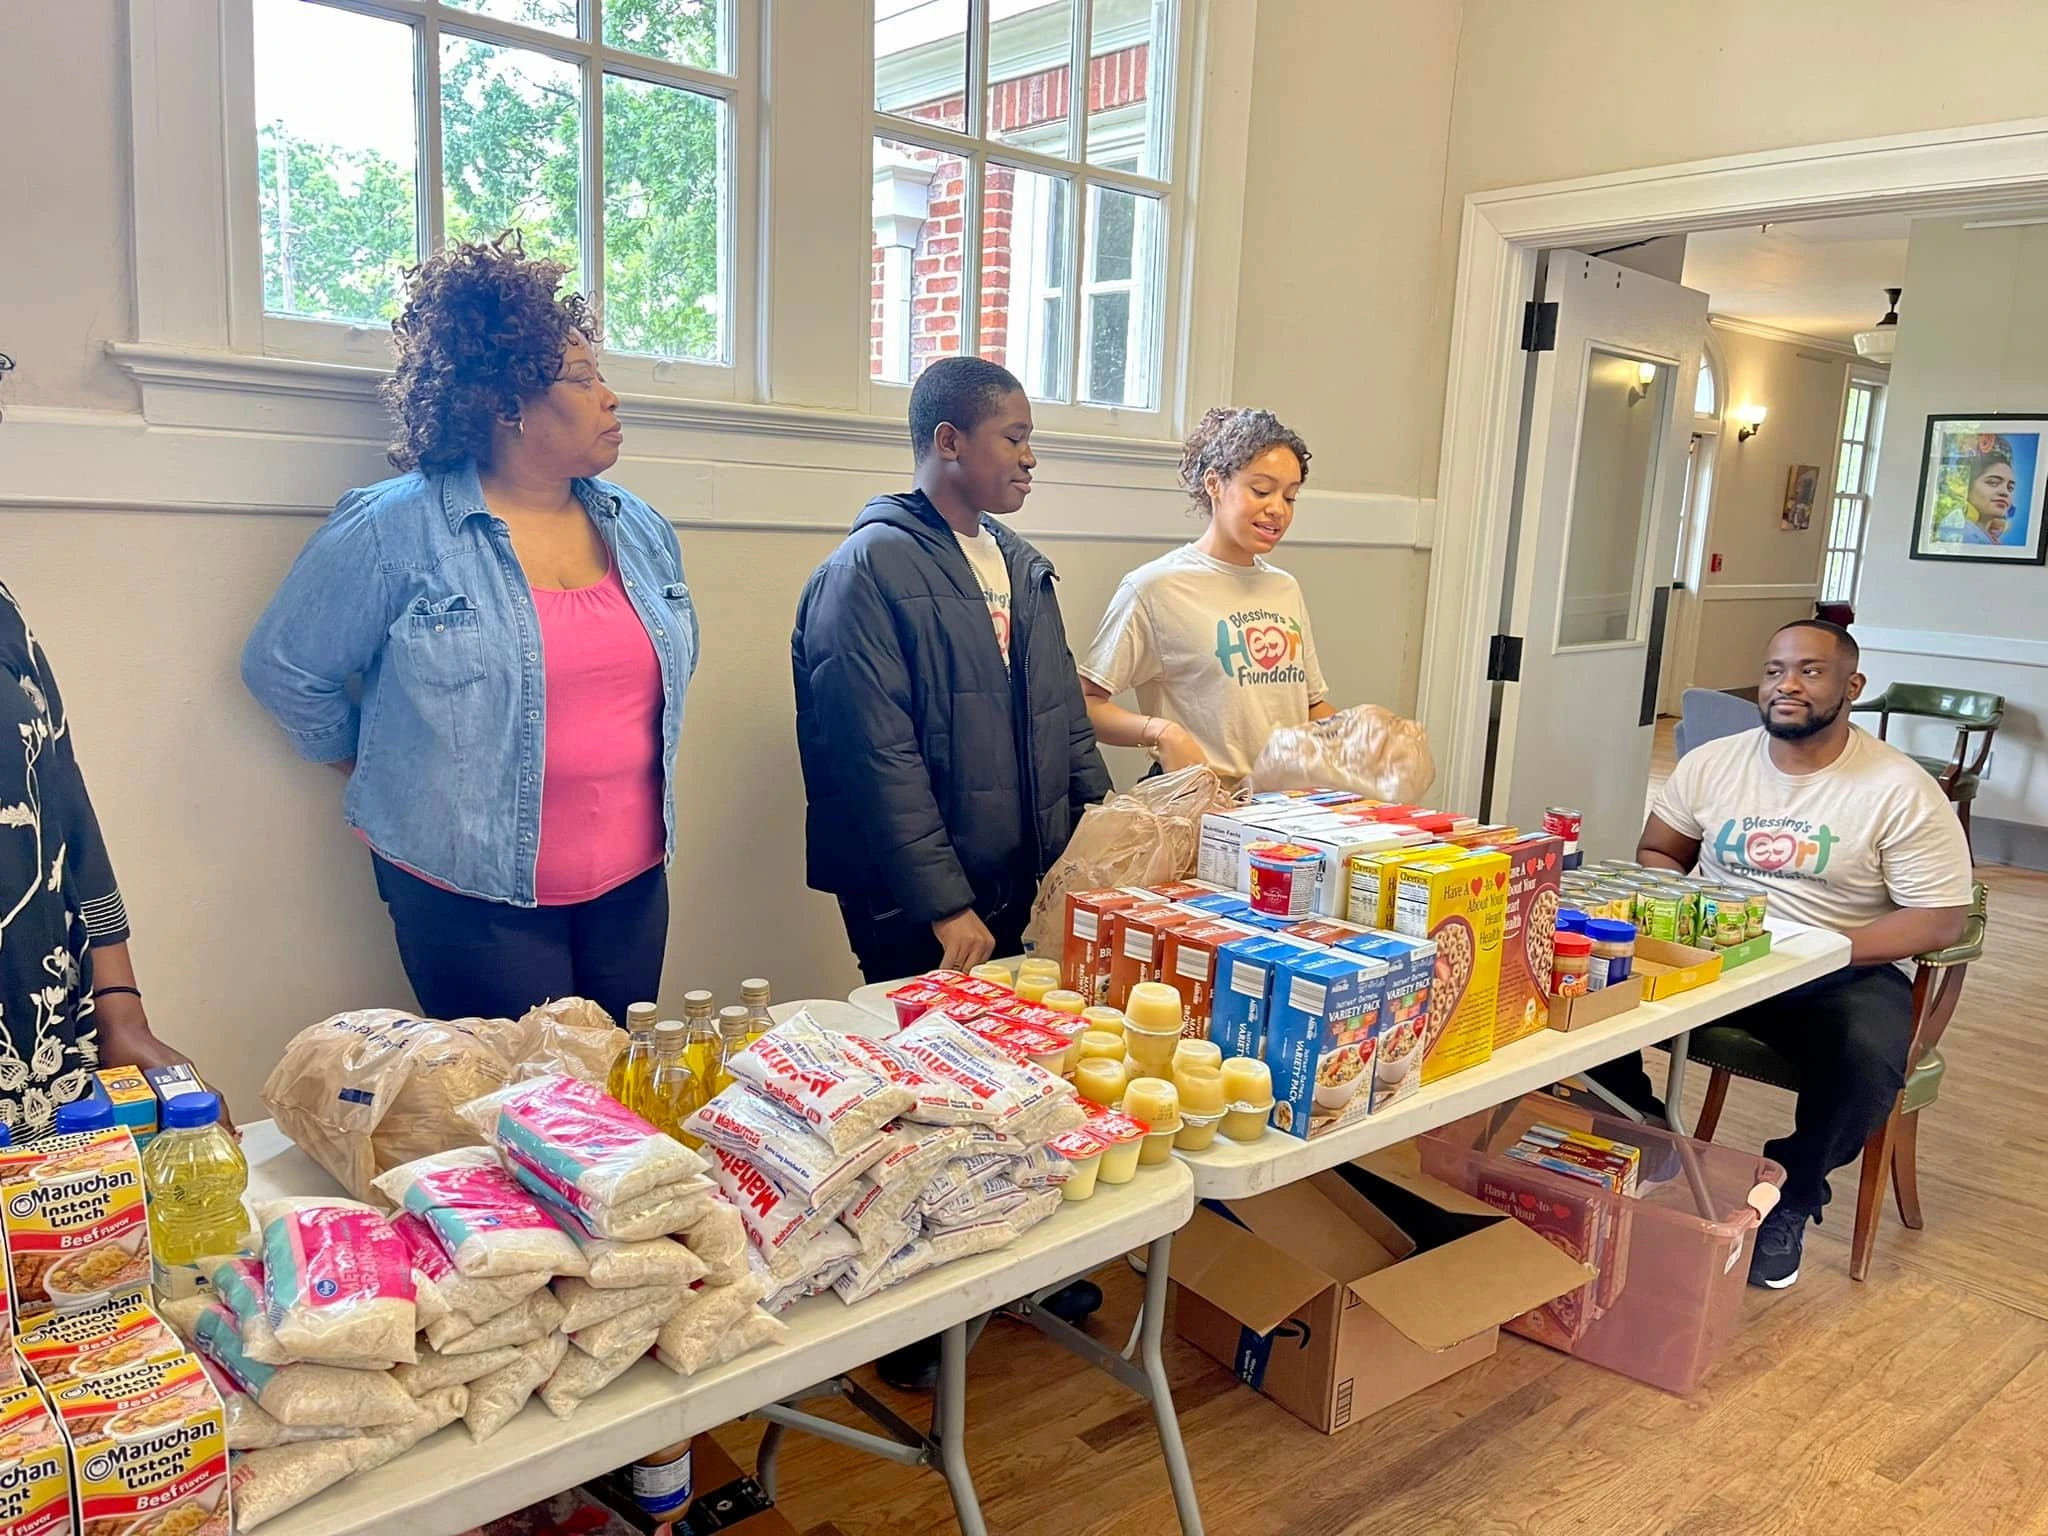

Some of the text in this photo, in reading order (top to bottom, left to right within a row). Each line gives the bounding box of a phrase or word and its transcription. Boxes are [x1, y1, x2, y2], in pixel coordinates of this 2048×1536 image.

[1229, 608, 1286, 628] Blessing's
[1742, 816, 1813, 834] Blessing's
[1714, 817, 1840, 874] Heart
[1521, 862, 1527, 876] A
[1444, 884, 1462, 900] Have
[1463, 882, 1470, 896] A
[1508, 881, 1523, 896] bout
[1467, 894, 1504, 912] About Your
[1485, 911, 1502, 926] Heart
[1480, 927, 1501, 944] Health
[1386, 977, 1431, 1000] VARIETY PACK
[1329, 999, 1382, 1022] VARIETY PACK
[1289, 1040, 1305, 1103] VARIETY PACK
[30, 1171, 134, 1204] Maruchan
[711, 1145, 781, 1218] Mahatm
[41, 1193, 111, 1218] Instant
[1509, 1192, 1516, 1203] A
[51, 1207, 105, 1228] Lunch
[1513, 1206, 1537, 1222] Your
[61, 1217, 129, 1248] Beef Flavor
[42, 1305, 138, 1337] Maruchan
[52, 1317, 120, 1341] Instant
[63, 1326, 118, 1344] Lunch
[79, 1334, 119, 1352] Beef
[81, 1356, 186, 1391] Maruchan
[93, 1373, 167, 1397] Instant
[104, 1381, 162, 1400] Lunch
[117, 1391, 158, 1411] Beef
[107, 1421, 215, 1466] Maruchan
[119, 1446, 192, 1480] Instant
[128, 1462, 185, 1489] Lunch
[136, 1485, 179, 1511] Beef
[179, 1470, 211, 1493] Flavor
[17, 1513, 52, 1535] Flavor
